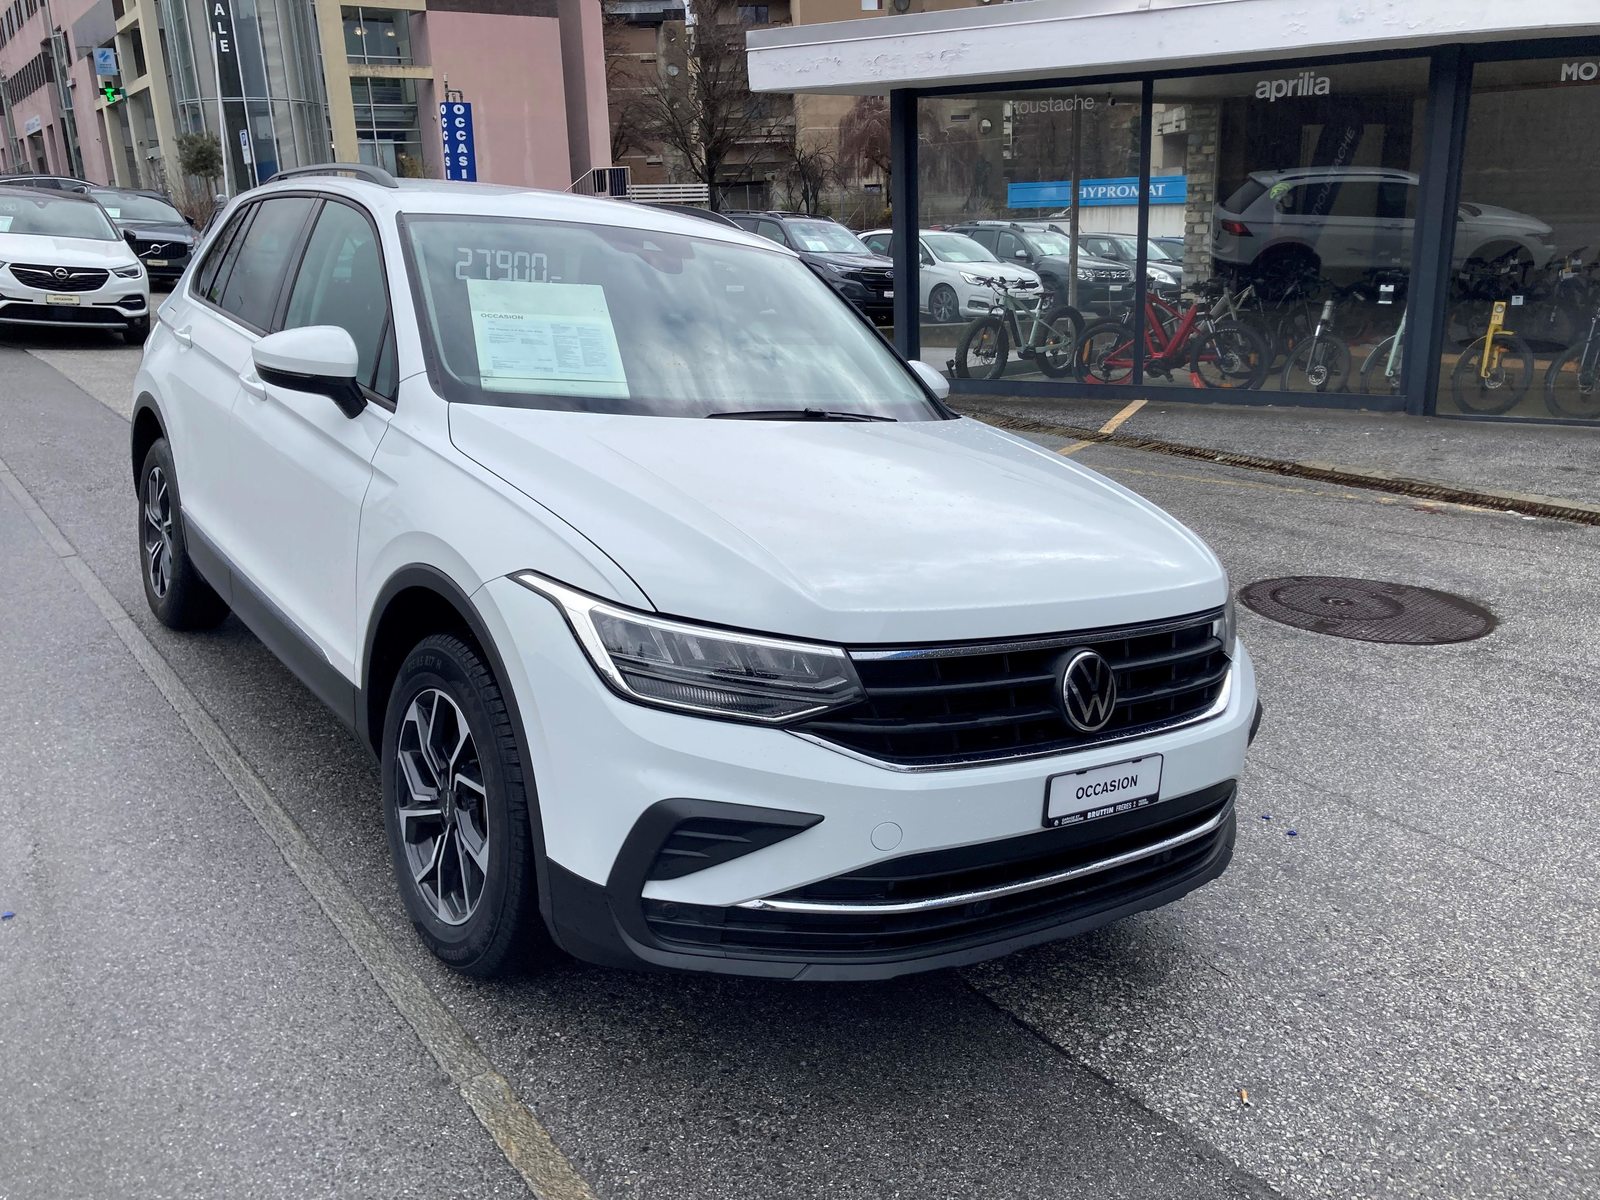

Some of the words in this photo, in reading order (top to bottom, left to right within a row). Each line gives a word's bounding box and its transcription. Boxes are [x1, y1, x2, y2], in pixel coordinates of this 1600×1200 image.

[1560, 62, 1600, 81] MO
[1255, 71, 1331, 102] aprilia
[453, 104, 468, 179] OCCASI
[480, 313, 524, 321] OCCASION
[1075, 774, 1139, 800] OCCASION
[1087, 806, 1115, 819] BRUTTIN
